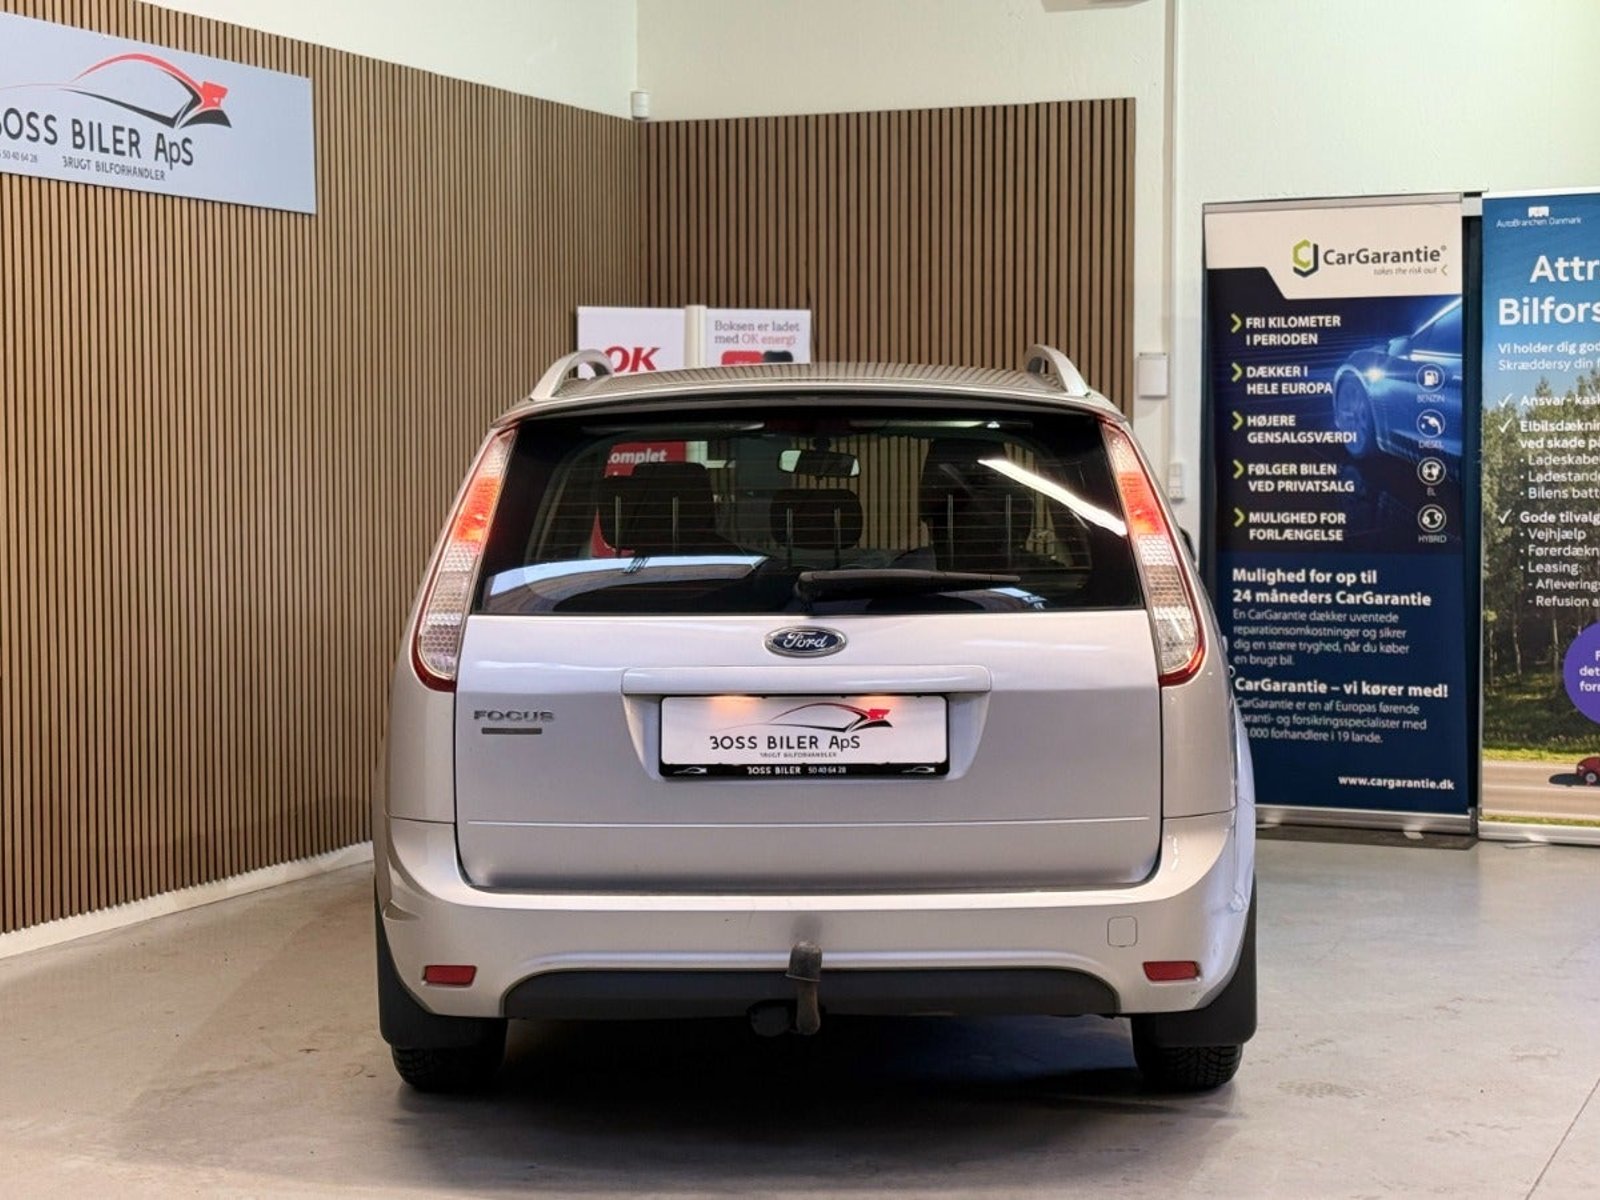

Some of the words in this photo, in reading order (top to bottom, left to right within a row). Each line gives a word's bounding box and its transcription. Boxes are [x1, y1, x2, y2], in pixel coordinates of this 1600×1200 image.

[0, 107, 58, 146] OSS
[71, 118, 142, 159] BILER
[154, 132, 193, 170] ApS
[95, 161, 166, 182] BILFORHANDLER
[1549, 216, 1582, 226] Danmark
[714, 320, 755, 332] Boksen
[757, 323, 769, 332] er
[772, 320, 800, 332] ladet
[1245, 317, 1265, 329] FRI
[1268, 315, 1341, 329] KILOMETER
[714, 334, 739, 344] med
[742, 334, 759, 344] OK
[762, 335, 796, 347] energi
[1246, 334, 1250, 346] I
[1253, 333, 1318, 346] PERIODEN
[1498, 343, 1511, 354] Vi
[1514, 342, 1553, 354] holder
[1556, 341, 1577, 356] dig
[604, 346, 661, 374] OK
[1499, 359, 1571, 372] Skræddersy
[1574, 357, 1594, 370] din
[1246, 366, 1301, 378] DÆKKER
[1304, 365, 1308, 377] I
[1247, 383, 1278, 394] HELE
[1281, 382, 1334, 394] EUROPA
[1247, 414, 1296, 427] HØJERE
[1247, 431, 1357, 444] GENSALGSVÆRDI
[1418, 440, 1444, 449] DIESEL
[1519, 438, 1544, 448] ved
[1546, 436, 1586, 448] skade
[607, 448, 668, 465] omplet
[1248, 464, 1298, 476] FØLGER
[1300, 464, 1337, 476] BILEN
[1248, 480, 1274, 492] VED
[1278, 480, 1355, 492] PRIVATSALG
[1528, 486, 1568, 499] Bilens
[1249, 512, 1317, 524] MULIGHED
[1320, 512, 1346, 524] FOR
[1520, 511, 1556, 524] Gode
[1249, 529, 1344, 541] FORLÆNGELSE
[1528, 528, 1587, 542] Vejhjælp
[1232, 568, 1306, 586] Mulighed
[1310, 569, 1331, 583] for
[1336, 572, 1357, 586] op
[1360, 570, 1377, 584] til
[1232, 589, 1252, 602] 24
[1256, 588, 1332, 604] måneders
[1336, 590, 1432, 606] CarGarantie
[1536, 596, 1590, 608] Refusion
[1233, 609, 1246, 620] En
[1248, 609, 1307, 621] CarGarantie
[1309, 611, 1347, 622] dækker
[1349, 612, 1399, 623] uventede
[1234, 625, 1360, 639] reparationsomkostninger
[1363, 628, 1377, 640] og
[1379, 628, 1407, 638] sikrer
[783, 631, 828, 650] Ford
[1234, 639, 1250, 650] dig
[1252, 641, 1266, 650] en
[1268, 640, 1297, 650] større
[1344, 640, 1360, 652] når
[1363, 641, 1377, 653] du
[1380, 642, 1410, 654] køber
[1234, 656, 1247, 664] en
[1250, 654, 1278, 668] brugt
[1235, 678, 1328, 694] CarGarantie
[1343, 682, 1358, 695] vi
[1362, 681, 1404, 696] kører
[1408, 684, 1448, 698] med!
[1296, 702, 1306, 710] er
[1308, 702, 1320, 711] en
[1324, 700, 1334, 711] af
[1336, 702, 1377, 714] Europas
[1379, 703, 1420, 714] førende
[474, 710, 555, 721] FOCUS
[1276, 717, 1290, 727] og
[1292, 716, 1400, 730] forsikringsspecialister
[1402, 719, 1427, 730] med
[1271, 728, 1329, 741] forhandlere
[1337, 732, 1350, 742] 19
[1352, 732, 1383, 744] lande.
[767, 735, 819, 750] BILER
[828, 735, 861, 752] ApS
[775, 766, 801, 775] BILER
[1338, 775, 1454, 790] www.cargarantie.dk
